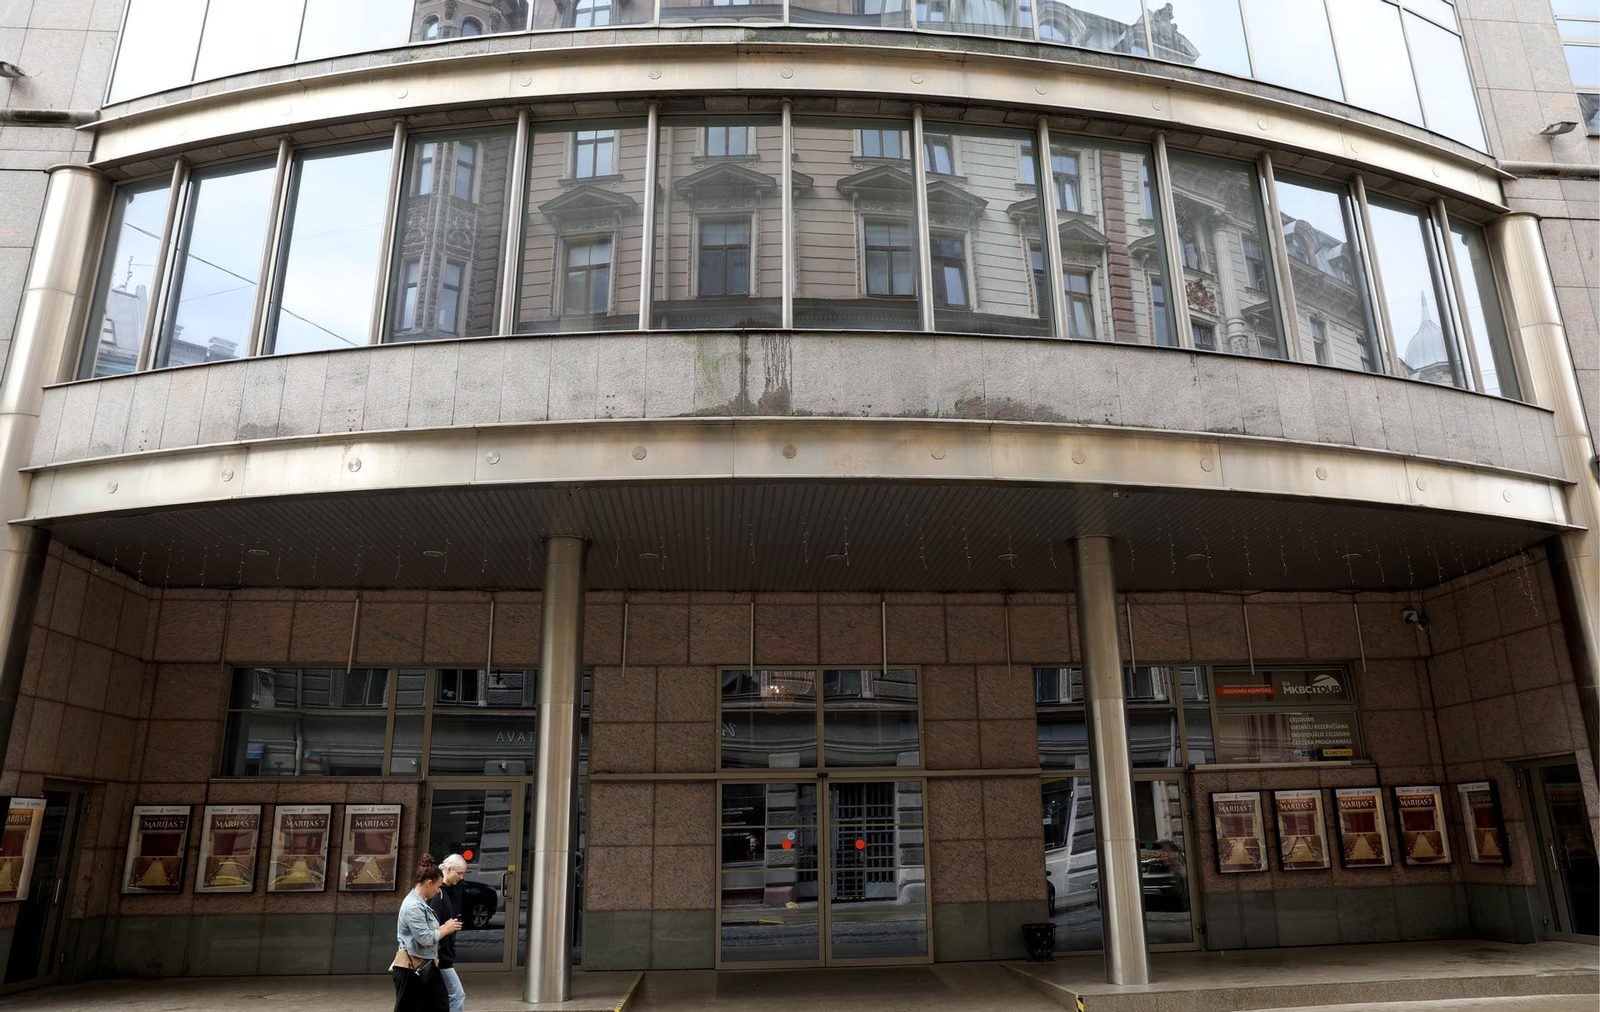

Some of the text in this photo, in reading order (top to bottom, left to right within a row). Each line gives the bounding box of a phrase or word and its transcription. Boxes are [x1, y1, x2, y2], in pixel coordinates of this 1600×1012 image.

[1280, 802, 1309, 811] MARIJAS
[1340, 800, 1369, 808] MARIJAS
[1400, 799, 1429, 807] MARIJAS
[1218, 804, 1247, 813] MARIJAS
[143, 820, 178, 829] MARIJAS
[215, 820, 249, 829] MARIJAS
[286, 820, 319, 829] MARIJAS
[355, 820, 389, 829] MARIJAS
